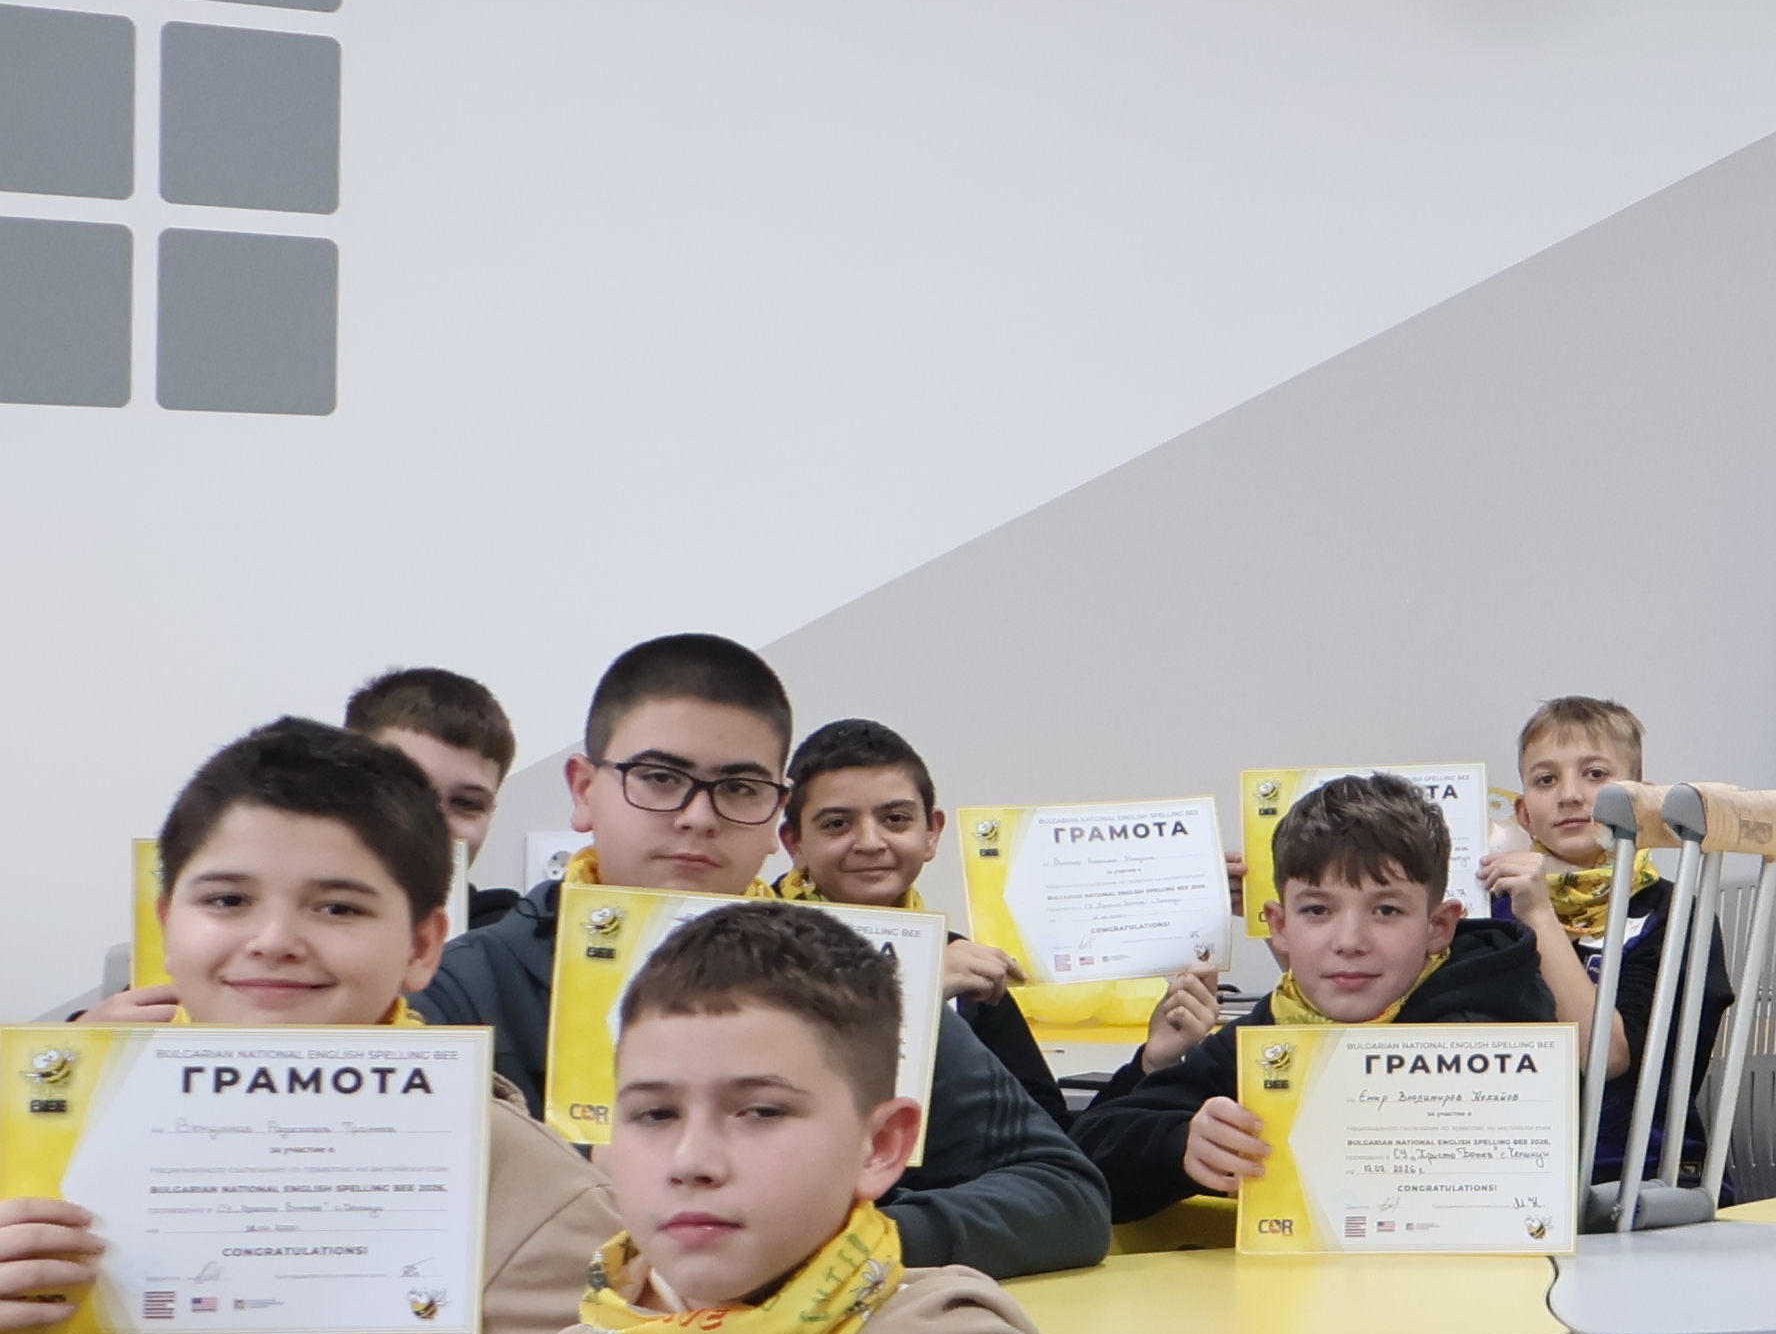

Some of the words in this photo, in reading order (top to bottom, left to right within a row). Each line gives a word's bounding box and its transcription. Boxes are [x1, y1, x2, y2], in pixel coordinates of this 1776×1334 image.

[1053, 820, 1188, 844] ГРАМОТА
[1365, 1053, 1538, 1074] ГРАМОТА
[181, 1066, 434, 1094] ГРАМОТА
[1264, 1079, 1289, 1088] BEE
[1397, 1183, 1497, 1191] CONGRATULATIONS!
[222, 1245, 368, 1257] CONGRATULATIONS!
